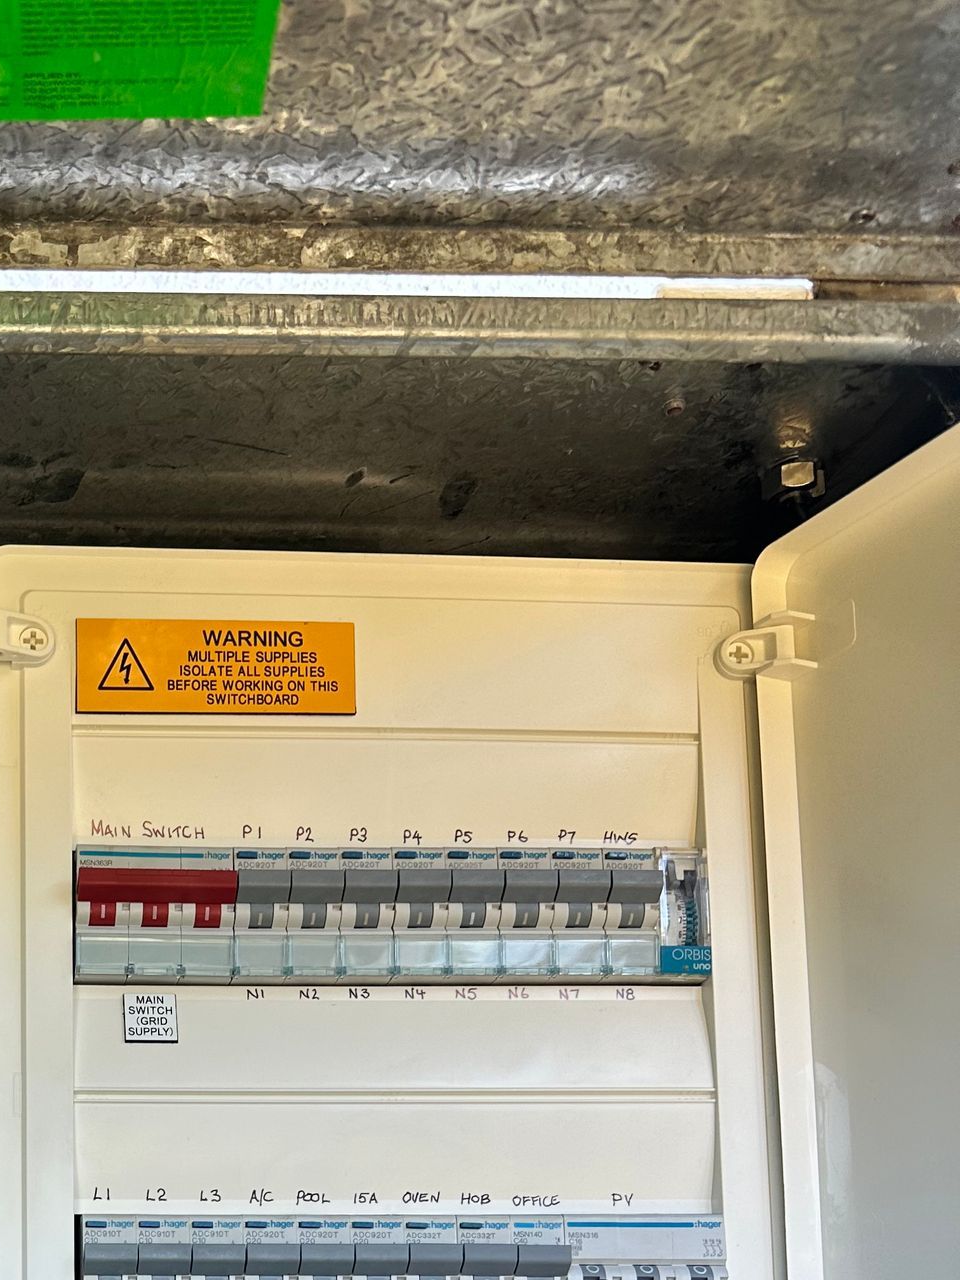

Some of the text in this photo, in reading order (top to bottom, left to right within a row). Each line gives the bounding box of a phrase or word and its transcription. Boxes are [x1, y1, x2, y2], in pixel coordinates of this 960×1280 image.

[203, 630, 304, 647] WARNING
[187, 651, 318, 663] MULTIPLE SUPPLIES
[179, 666, 325, 677] ISOLATE ALL SUPPLIES
[167, 680, 338, 692] BEFORE WORKING ON THIS
[206, 694, 299, 705] SWITCHBOARD
[91, 819, 204, 839] MAIN SWITCH
[242, 824, 262, 838] P1
[296, 827, 314, 841] P2
[350, 828, 368, 842] P3
[403, 829, 422, 844] P4
[454, 829, 472, 843] P5
[508, 830, 528, 843] P6
[558, 829, 576, 843] P7
[672, 949, 710, 960] ORBIS
[247, 989, 264, 999] N1
[300, 989, 319, 999] N2
[349, 989, 370, 999] N3
[405, 988, 426, 999] N4
[456, 988, 477, 999] N5
[508, 987, 529, 999] N6
[559, 988, 580, 999] N7
[616, 988, 635, 1000] N8
[136, 996, 164, 1004] MAIN
[129, 1007, 173, 1015] SWITCH
[136, 1016, 168, 1025] (GRID
[128, 1027, 174, 1037] SUPPLY)
[93, 1188, 110, 1200] L1
[147, 1189, 167, 1201] L2
[200, 1189, 221, 1202] L3
[250, 1190, 274, 1205] A/C
[297, 1190, 330, 1206] POOL
[354, 1192, 378, 1204] 15A
[403, 1191, 441, 1204] OVEN
[461, 1192, 490, 1204] HOB
[612, 1194, 633, 1206] PV
[512, 1194, 560, 1207] OFFICE
